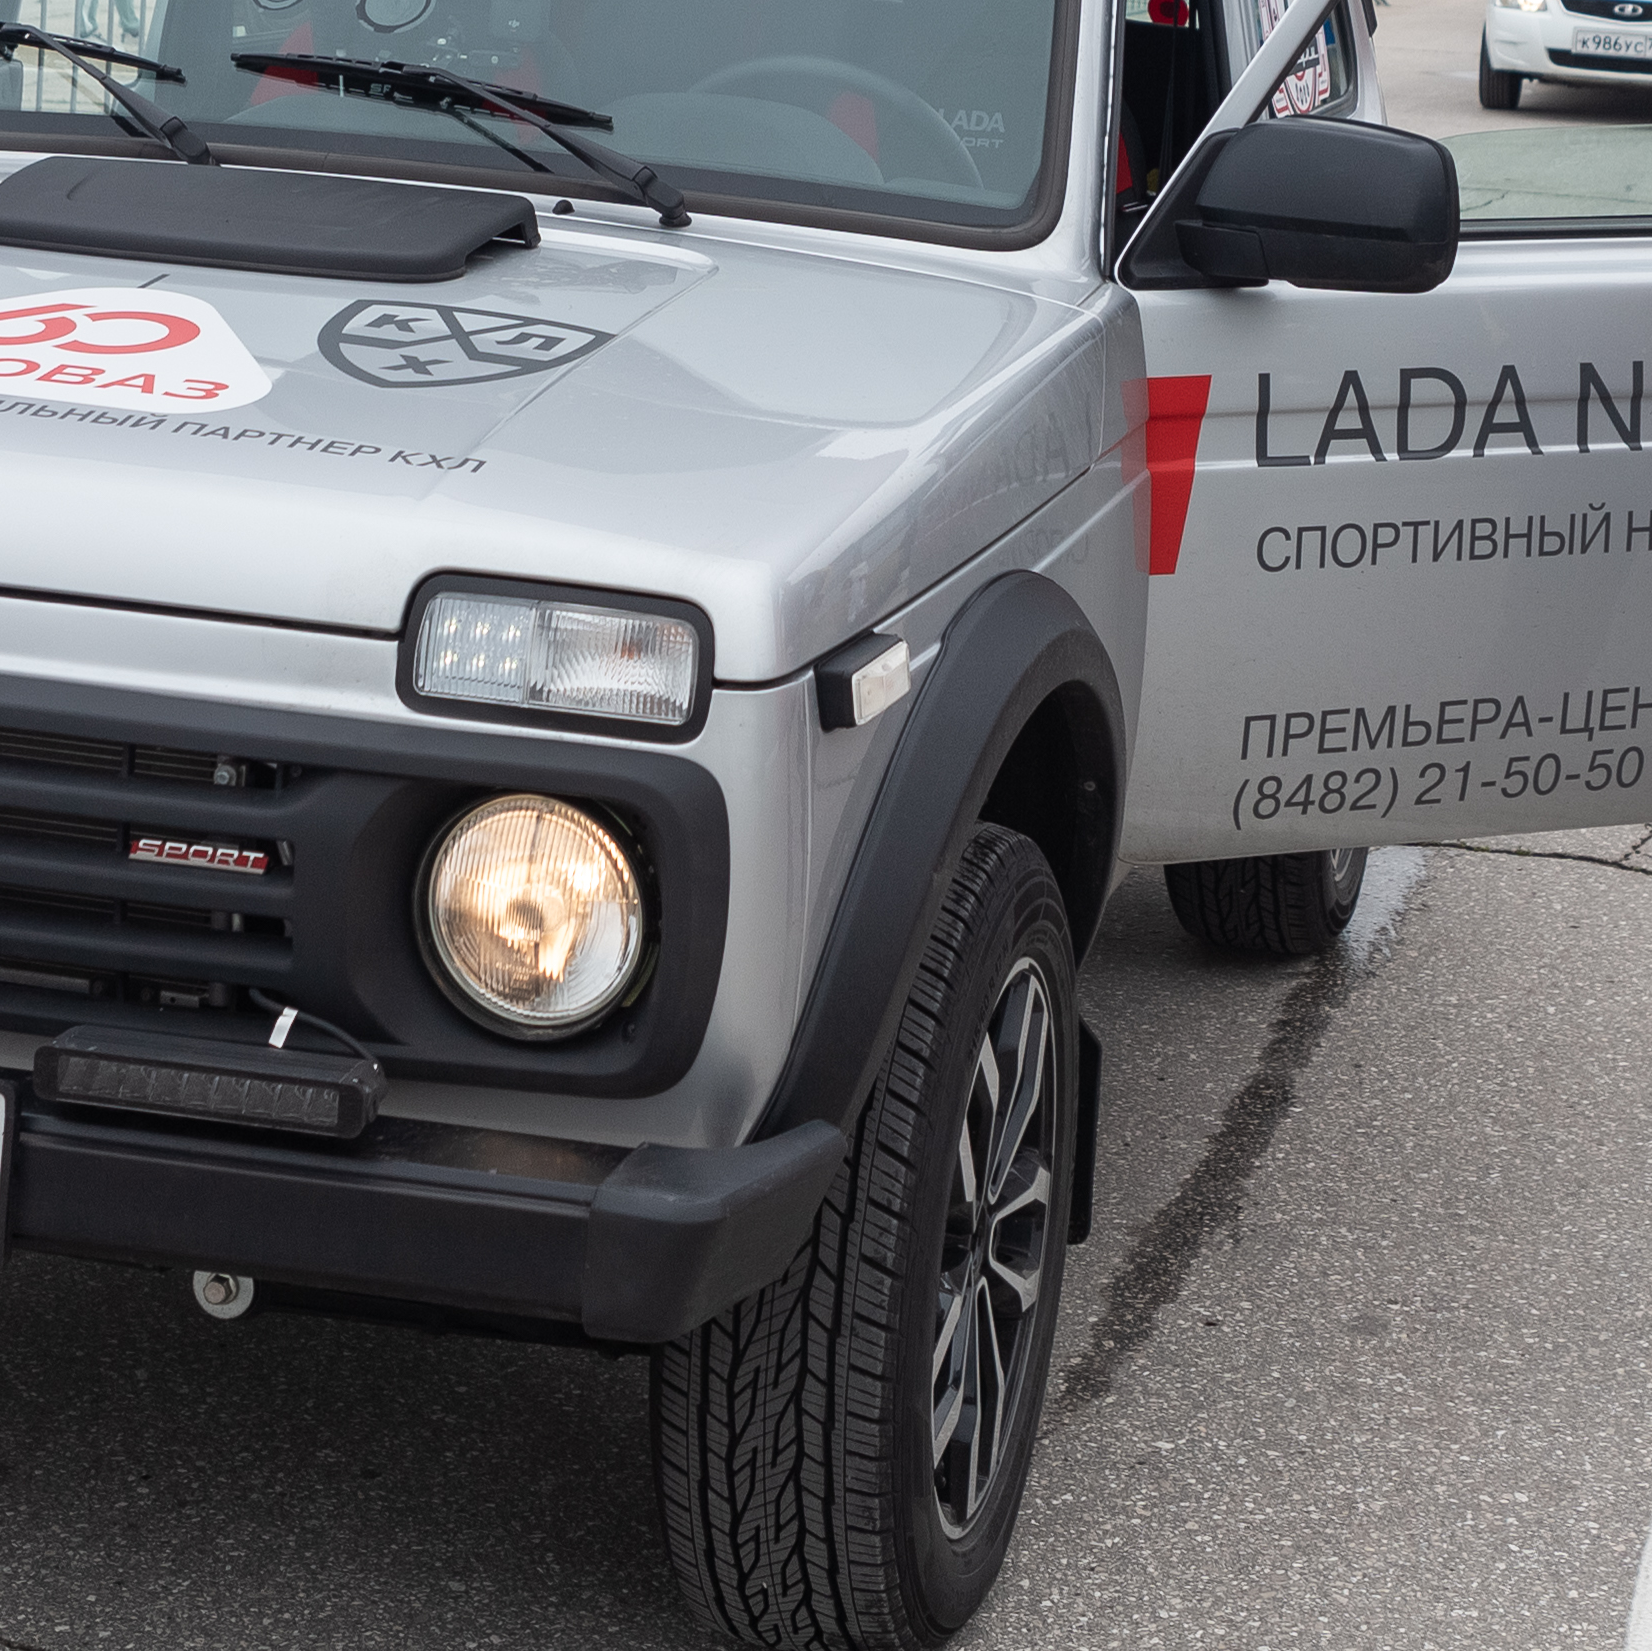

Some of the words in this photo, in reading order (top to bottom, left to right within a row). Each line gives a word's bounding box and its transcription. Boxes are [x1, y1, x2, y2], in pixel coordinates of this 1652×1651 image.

[171, 420, 383, 459] ПАРТНЕР
[387, 447, 488, 474] КХЛ
[1254, 362, 1543, 467] LADA
[1255, 502, 1612, 573] СПОРТИВНЫЙ
[1231, 763, 1399, 830] (8482)
[1414, 745, 1646, 807] 21-50-50
[138, 838, 265, 870] SPORT
